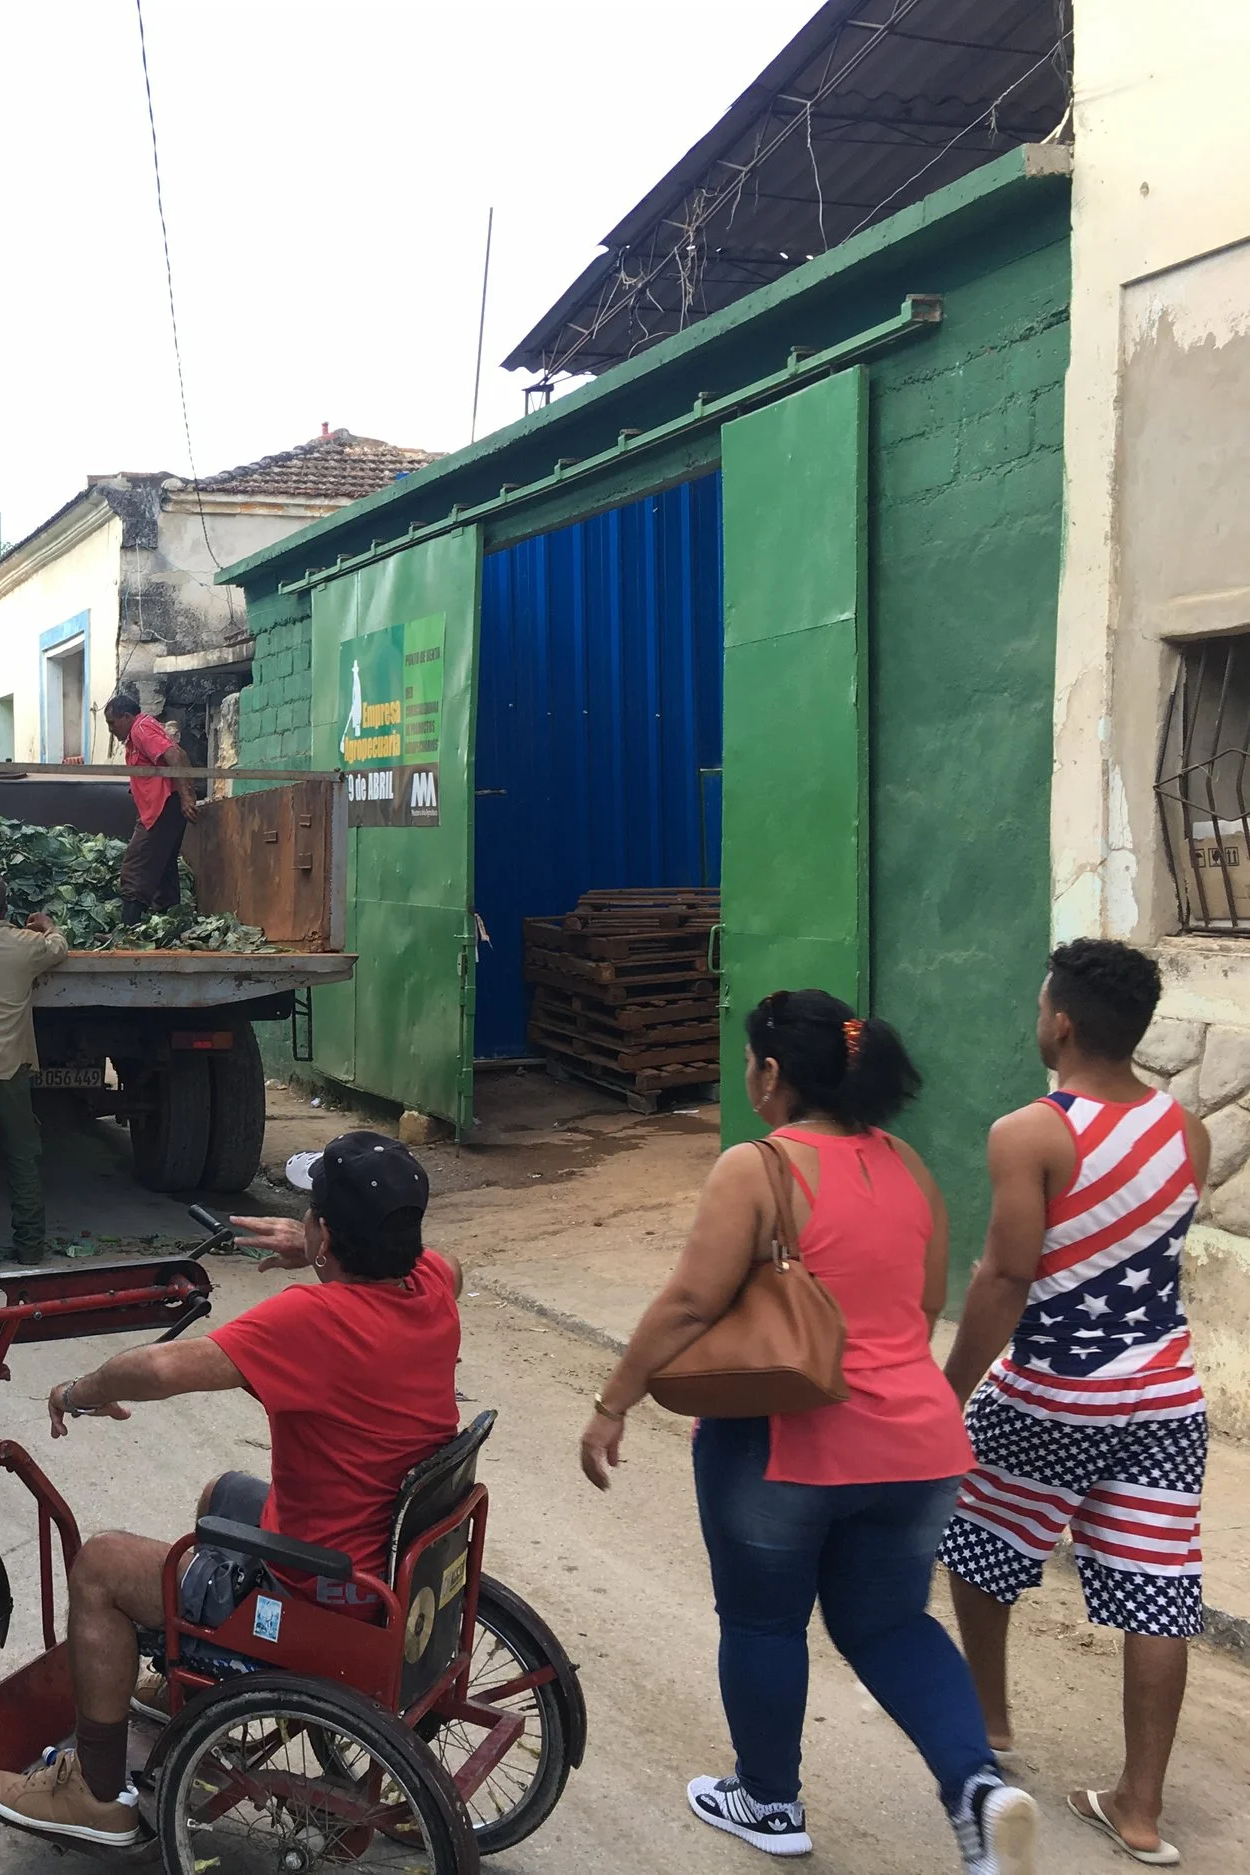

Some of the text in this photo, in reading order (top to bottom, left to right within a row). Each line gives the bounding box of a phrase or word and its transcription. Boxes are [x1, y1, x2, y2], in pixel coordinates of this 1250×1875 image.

[363, 700, 401, 730] Empresa
[344, 729, 401, 764] Agropecuaria
[346, 770, 394, 802] 9 de ABRIL
[46, 1070, 71, 1086] 056
[74, 1070, 100, 1086] 449
